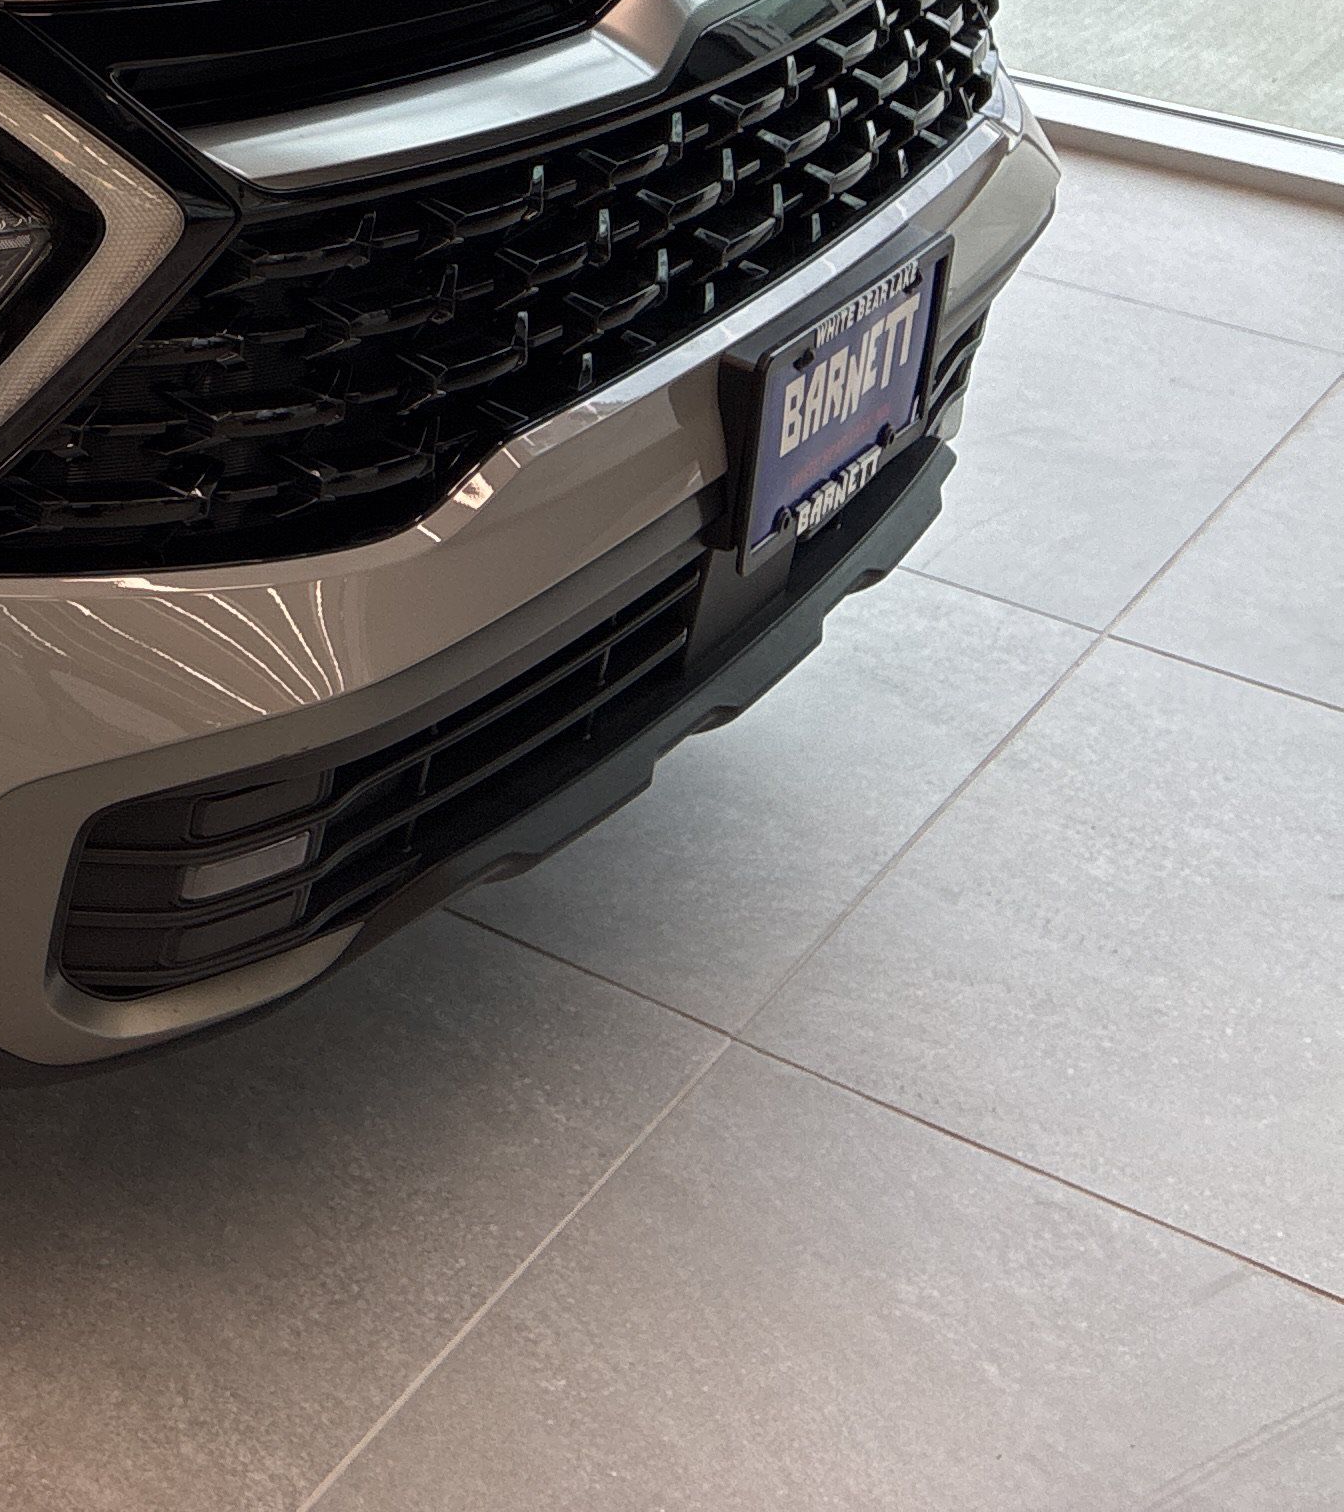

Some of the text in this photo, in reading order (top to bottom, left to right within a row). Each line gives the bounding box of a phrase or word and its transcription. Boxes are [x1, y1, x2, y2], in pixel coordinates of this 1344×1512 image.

[816, 259, 919, 349] WHITE BEAR LAKE
[779, 292, 921, 458] BARNETT
[794, 445, 882, 538] BARNETT
